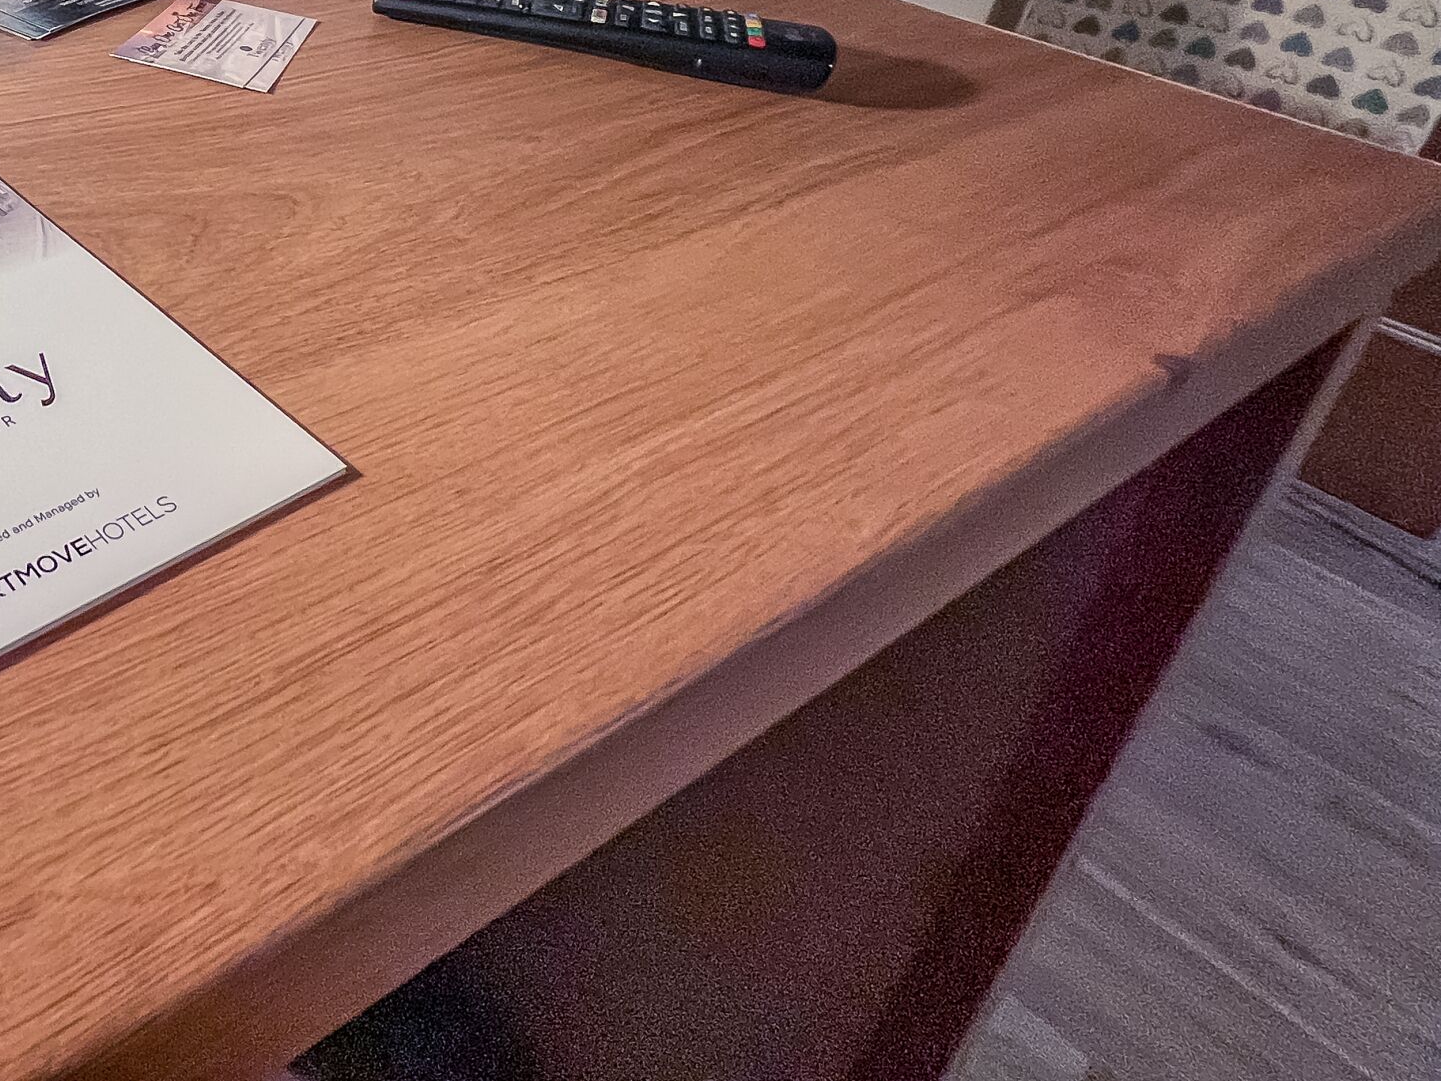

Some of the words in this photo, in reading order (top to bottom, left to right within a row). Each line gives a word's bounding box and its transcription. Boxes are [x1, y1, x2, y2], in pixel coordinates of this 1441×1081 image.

[12, 518, 34, 535] and
[34, 493, 85, 523] Managed
[85, 487, 101, 500] by
